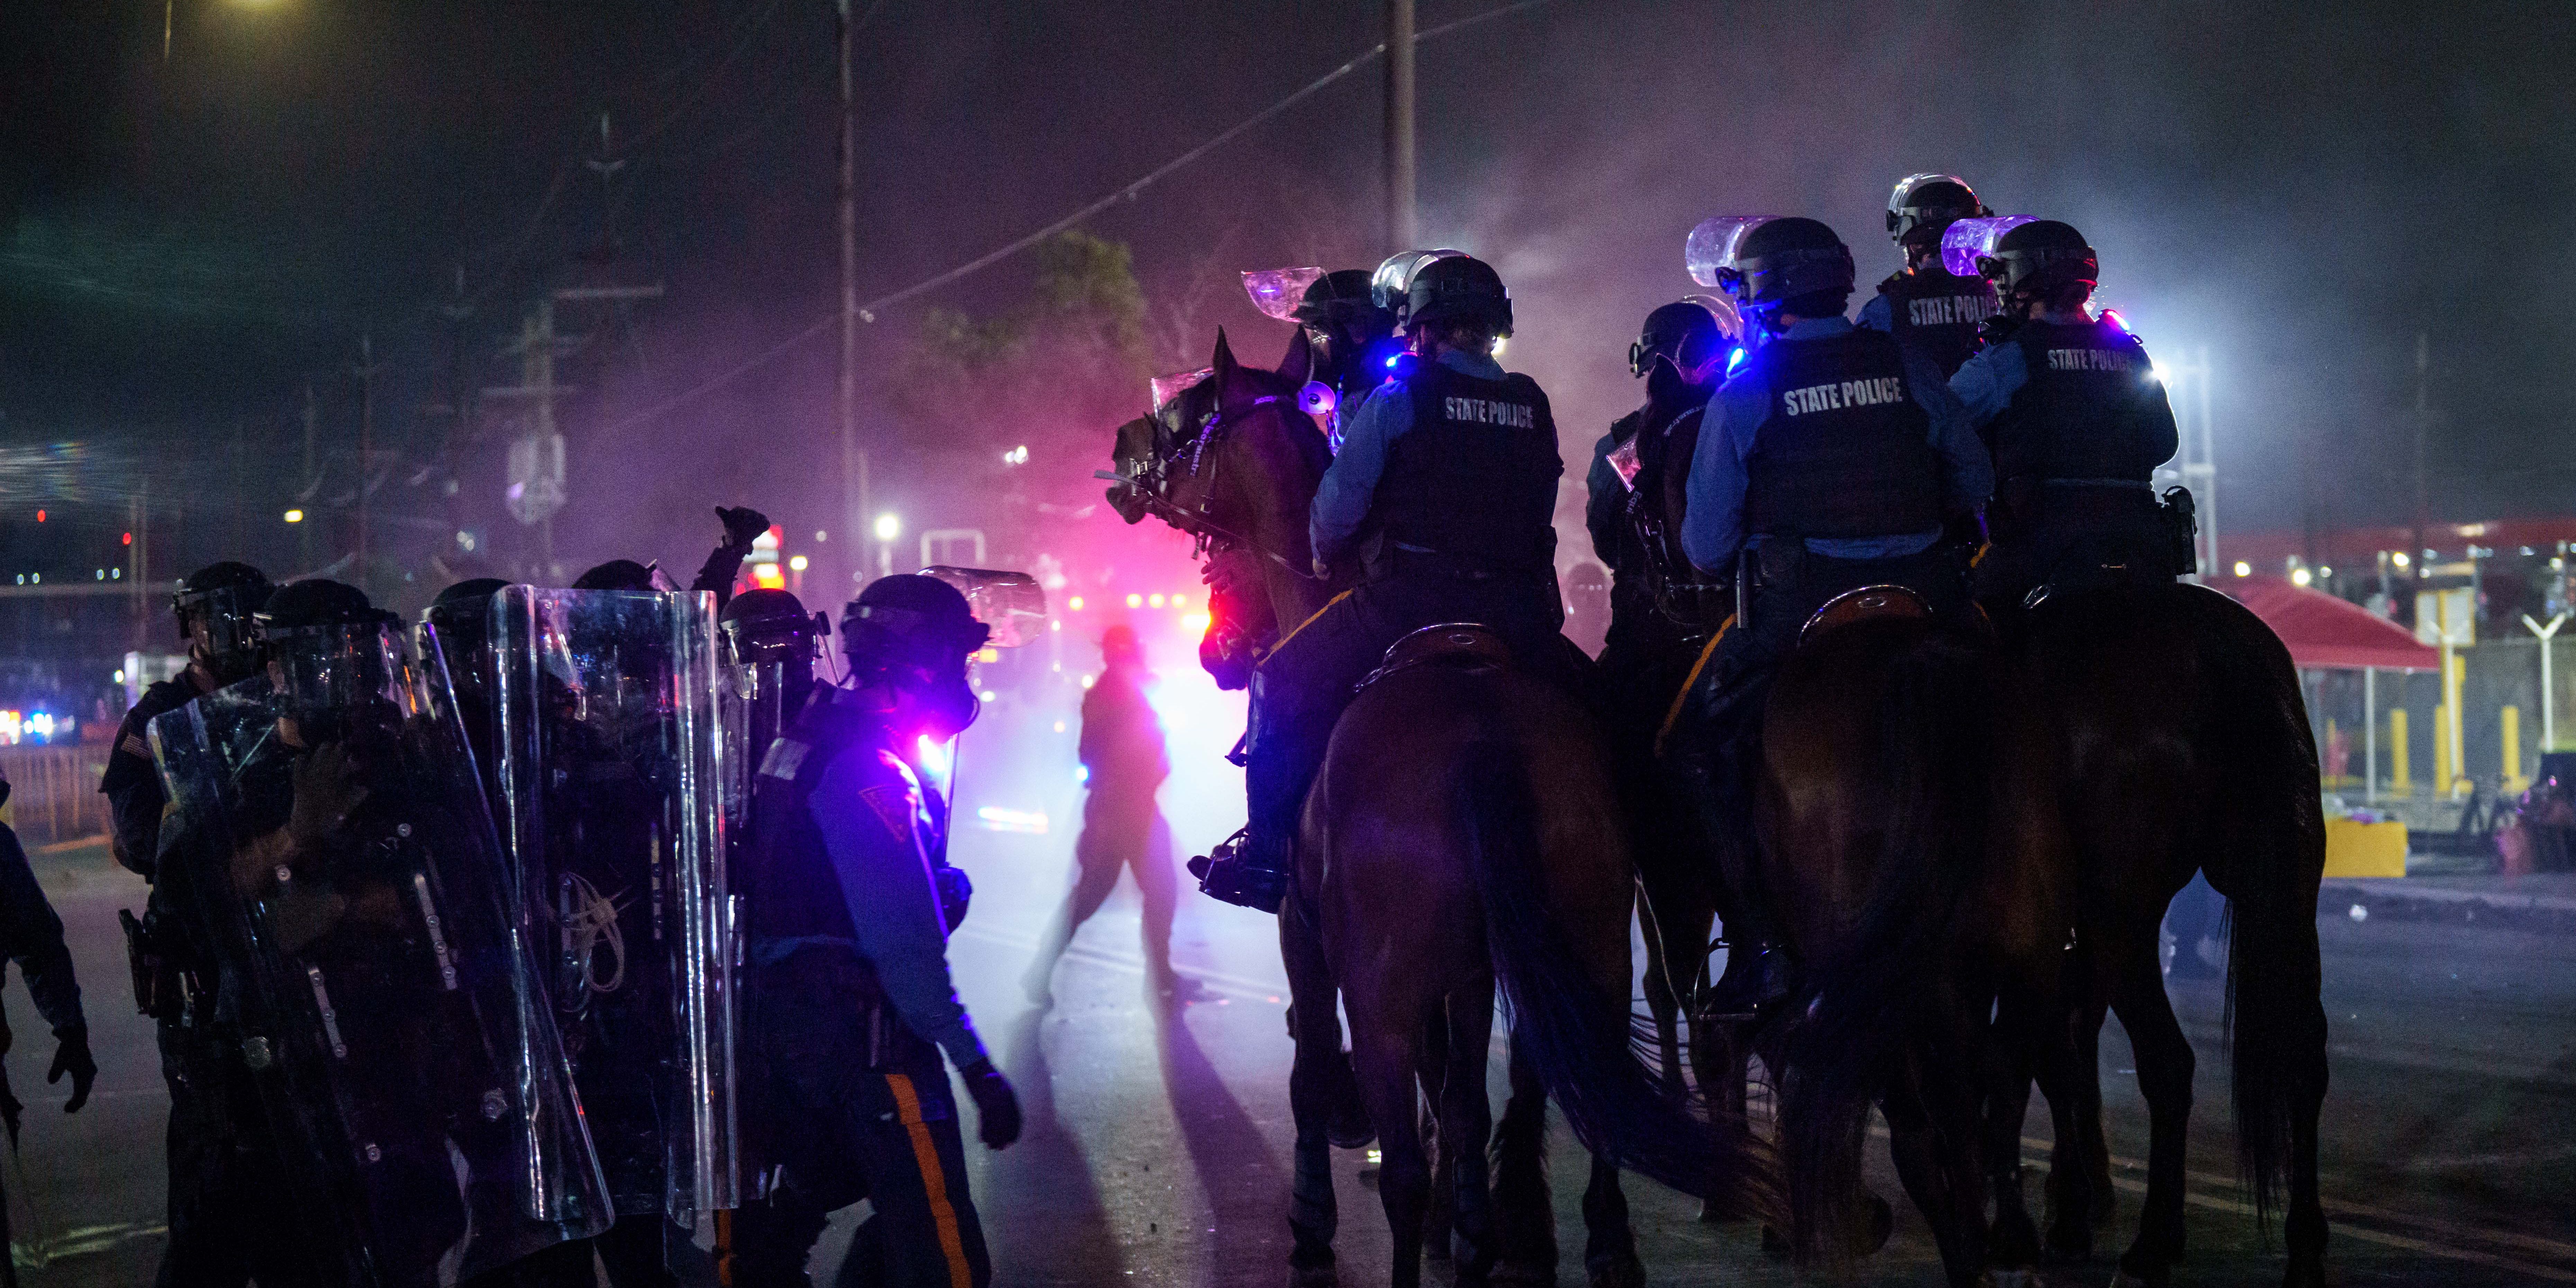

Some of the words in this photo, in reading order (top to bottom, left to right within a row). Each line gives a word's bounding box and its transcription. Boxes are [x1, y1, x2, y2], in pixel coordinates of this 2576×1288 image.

[1909, 296, 1954, 326] STATE
[1954, 295, 1997, 324] POLIC
[2047, 349, 2089, 370] STATE
[1445, 396, 1486, 423] STATE
[1488, 400, 1534, 429] POLICE
[1783, 383, 1841, 416] STATE
[1841, 377, 1903, 408] POLICE
